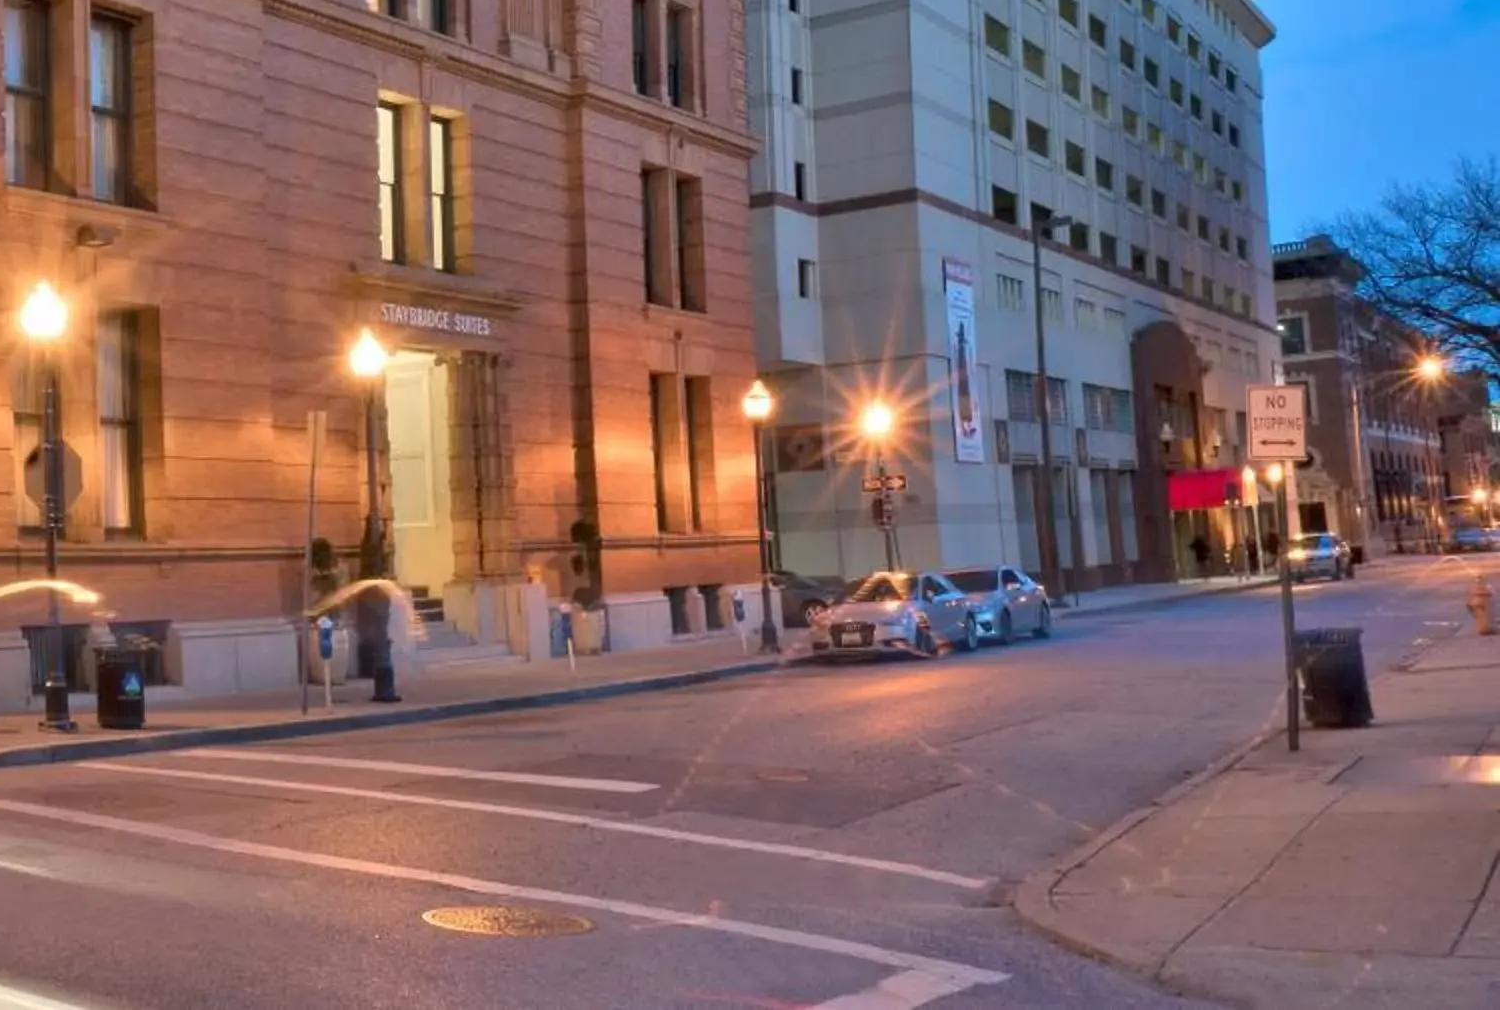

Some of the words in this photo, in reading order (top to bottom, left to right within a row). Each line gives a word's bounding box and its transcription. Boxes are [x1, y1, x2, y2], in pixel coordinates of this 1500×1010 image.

[381, 303, 450, 329] STAYBRIDGE
[453, 313, 490, 335] SUITES
[1266, 395, 1286, 409] NO
[1253, 417, 1302, 431] STOPPING
